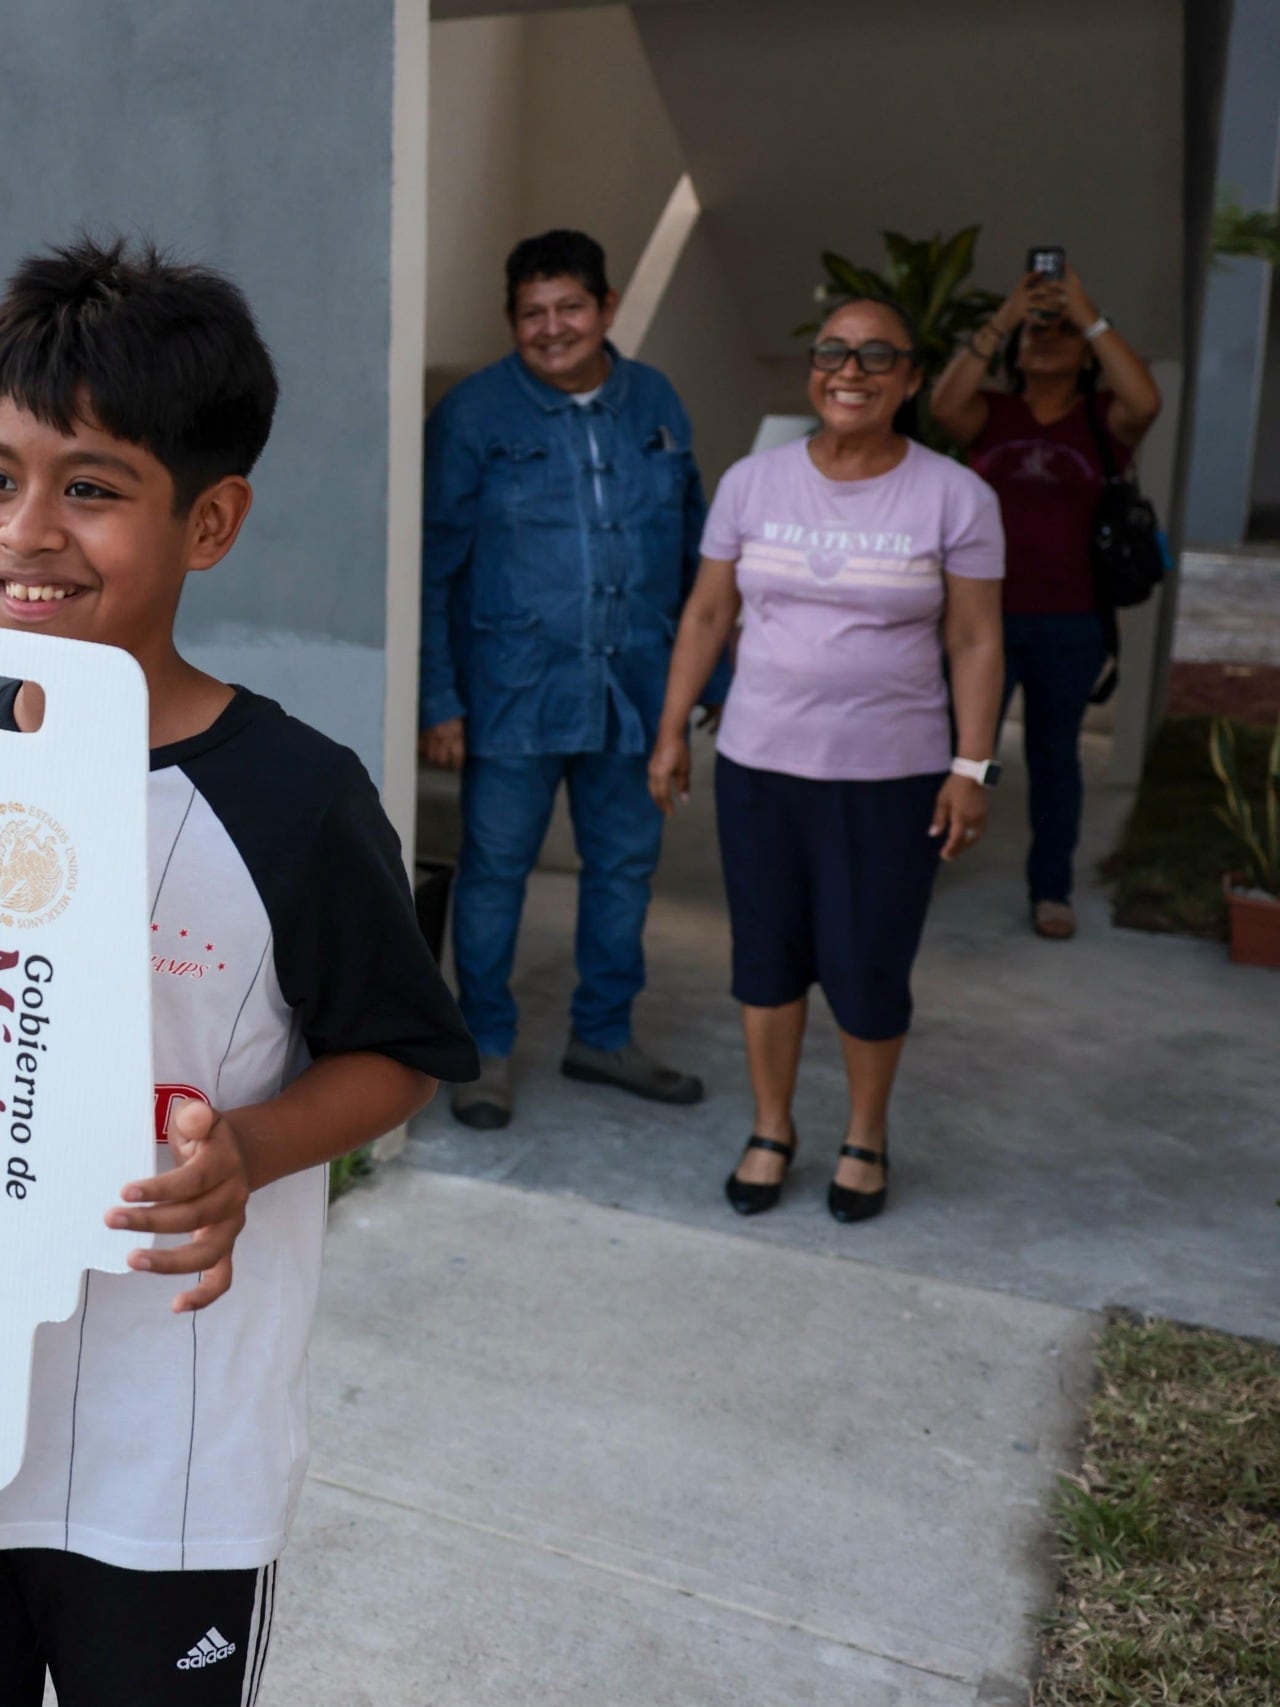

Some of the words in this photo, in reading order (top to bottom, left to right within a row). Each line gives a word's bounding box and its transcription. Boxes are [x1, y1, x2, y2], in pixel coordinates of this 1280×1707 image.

[763, 522, 913, 553] WHATEVER
[29, 806, 69, 843] ESTADOS
[66, 847, 78, 891] UNIDOS
[17, 895, 72, 928] MEXICANOS
[10, 953, 55, 1145] Gobierno
[5, 1156, 37, 1201] de
[176, 1642, 236, 1670] adidas
